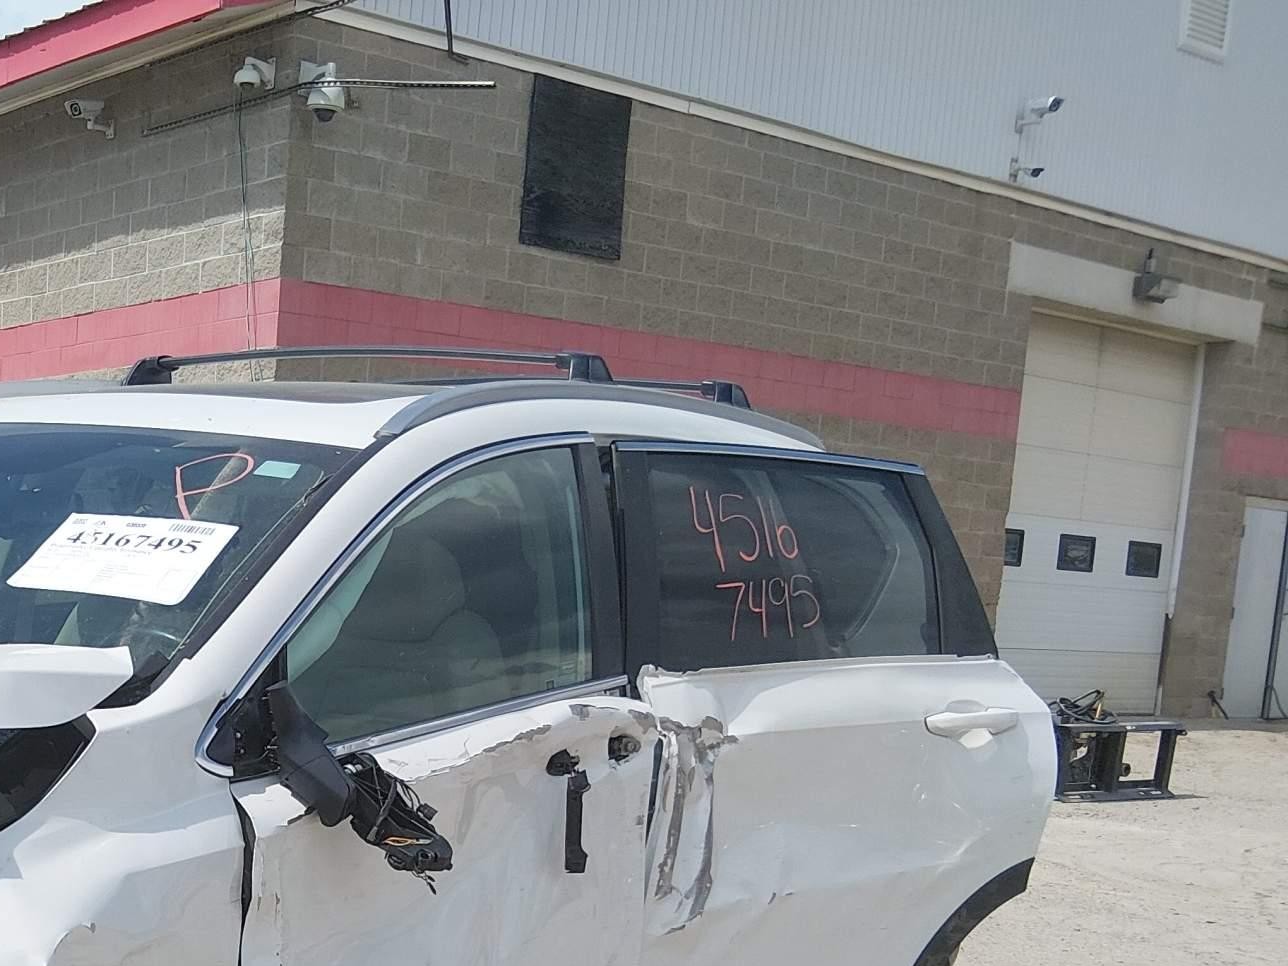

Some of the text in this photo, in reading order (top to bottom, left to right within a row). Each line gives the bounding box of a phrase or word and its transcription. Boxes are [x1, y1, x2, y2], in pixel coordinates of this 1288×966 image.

[175, 452, 255, 520] P
[66, 530, 202, 554] 45167495
[689, 485, 799, 573] 4516
[715, 574, 820, 641] 7495
